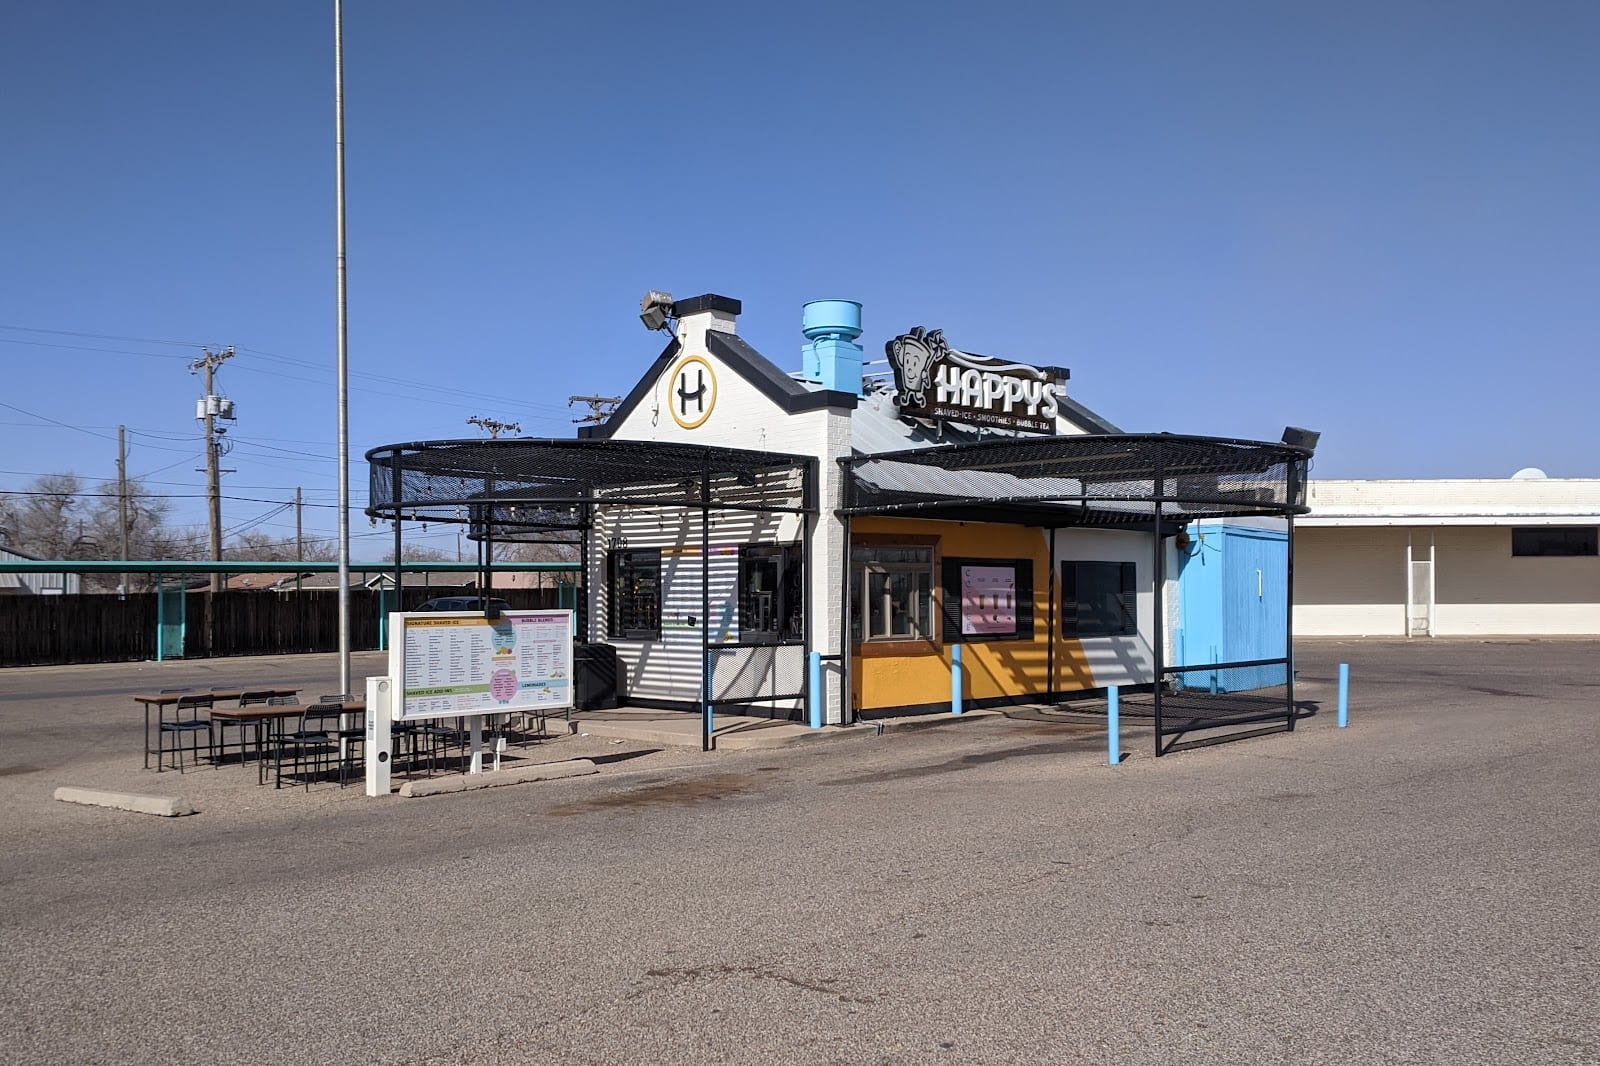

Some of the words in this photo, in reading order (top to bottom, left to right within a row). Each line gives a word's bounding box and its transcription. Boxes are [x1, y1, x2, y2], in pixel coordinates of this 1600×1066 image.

[677, 369, 707, 416] H
[934, 364, 1058, 419] HAPPYS
[934, 407, 972, 420] SHAVED-ICE
[978, 414, 1012, 425] SMOOTHIES
[1016, 418, 1039, 429] BUBBLE
[1039, 421, 1050, 431] TEA
[607, 535, 628, 550] 1708
